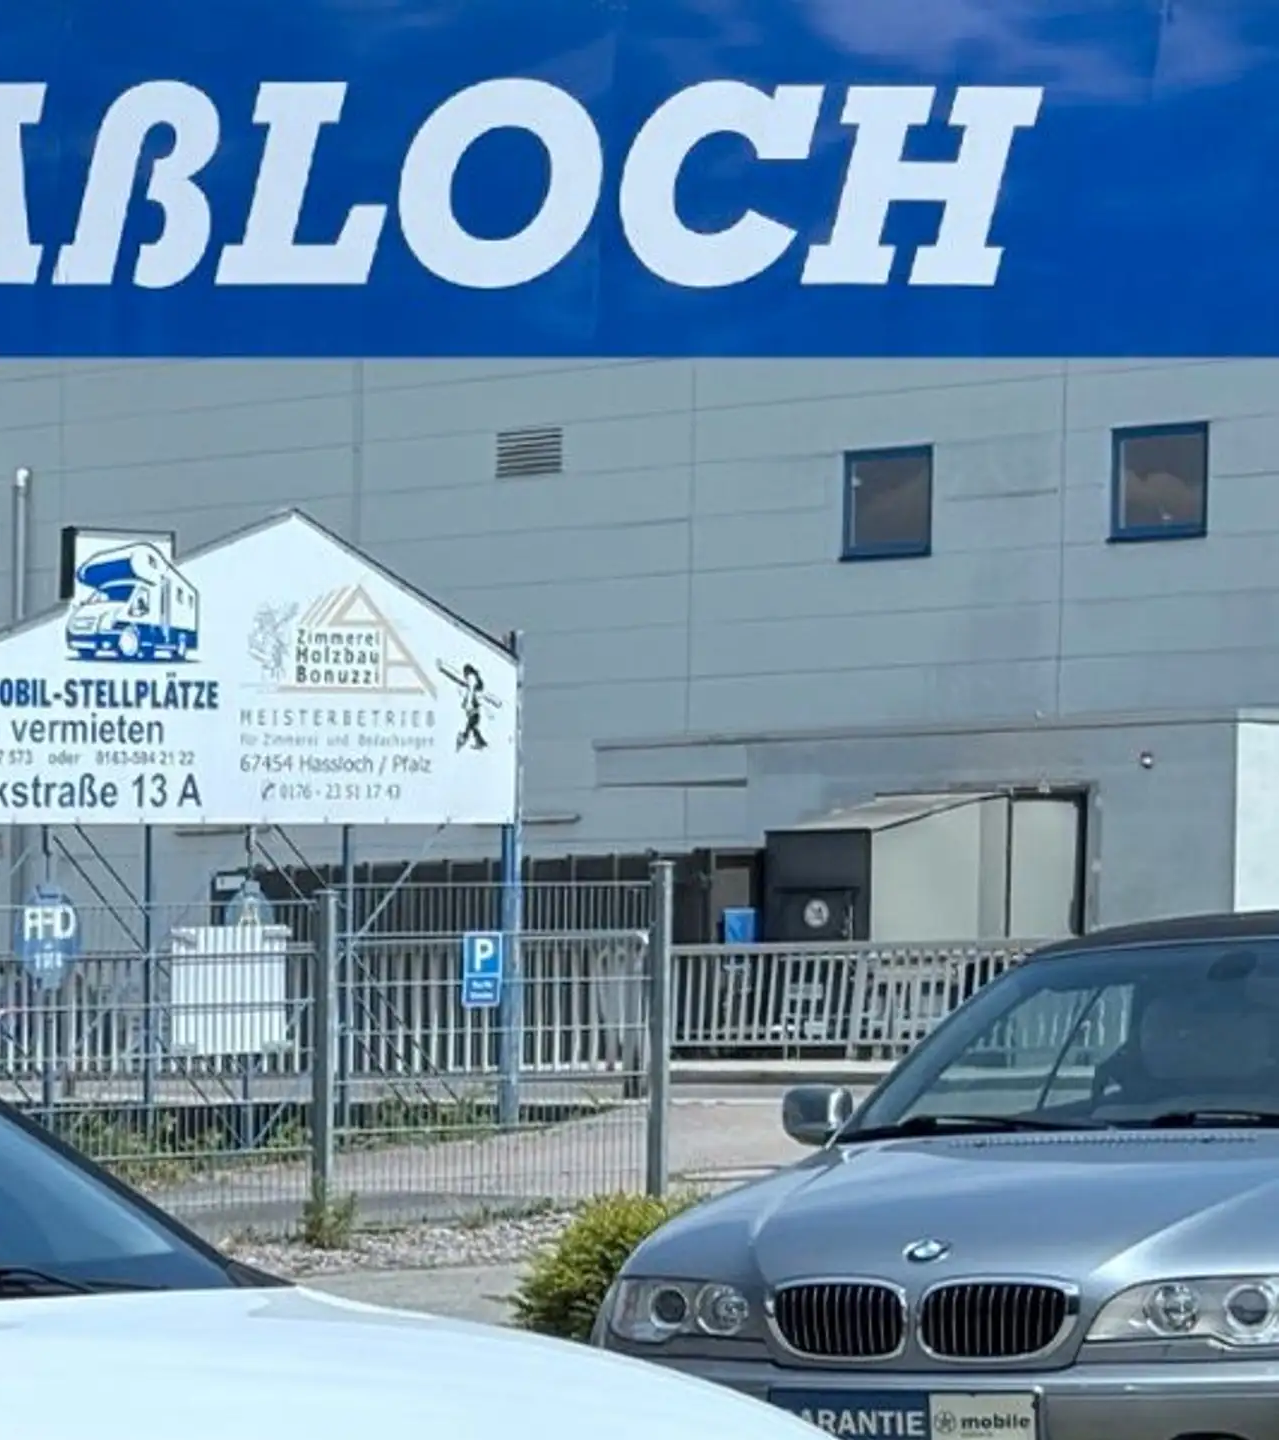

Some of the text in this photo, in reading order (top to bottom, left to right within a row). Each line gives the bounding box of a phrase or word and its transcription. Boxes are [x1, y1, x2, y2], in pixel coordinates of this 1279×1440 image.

[296, 628, 380, 646] Zimmerei
[295, 646, 380, 665] Holzbau
[295, 665, 380, 685] Bonuzzi
[11, 712, 165, 744] vermieten
[240, 708, 436, 729] MEISTERBETRIEB
[48, 748, 81, 766] oder
[239, 753, 293, 773] 67454
[298, 753, 374, 774] Hassloch
[391, 754, 434, 774] Pfalz
[131, 772, 168, 809] 13
[176, 772, 203, 809] A
[474, 937, 494, 973] P
[797, 1408, 926, 1437] ARANTIE
[960, 1411, 1032, 1430] mobile
